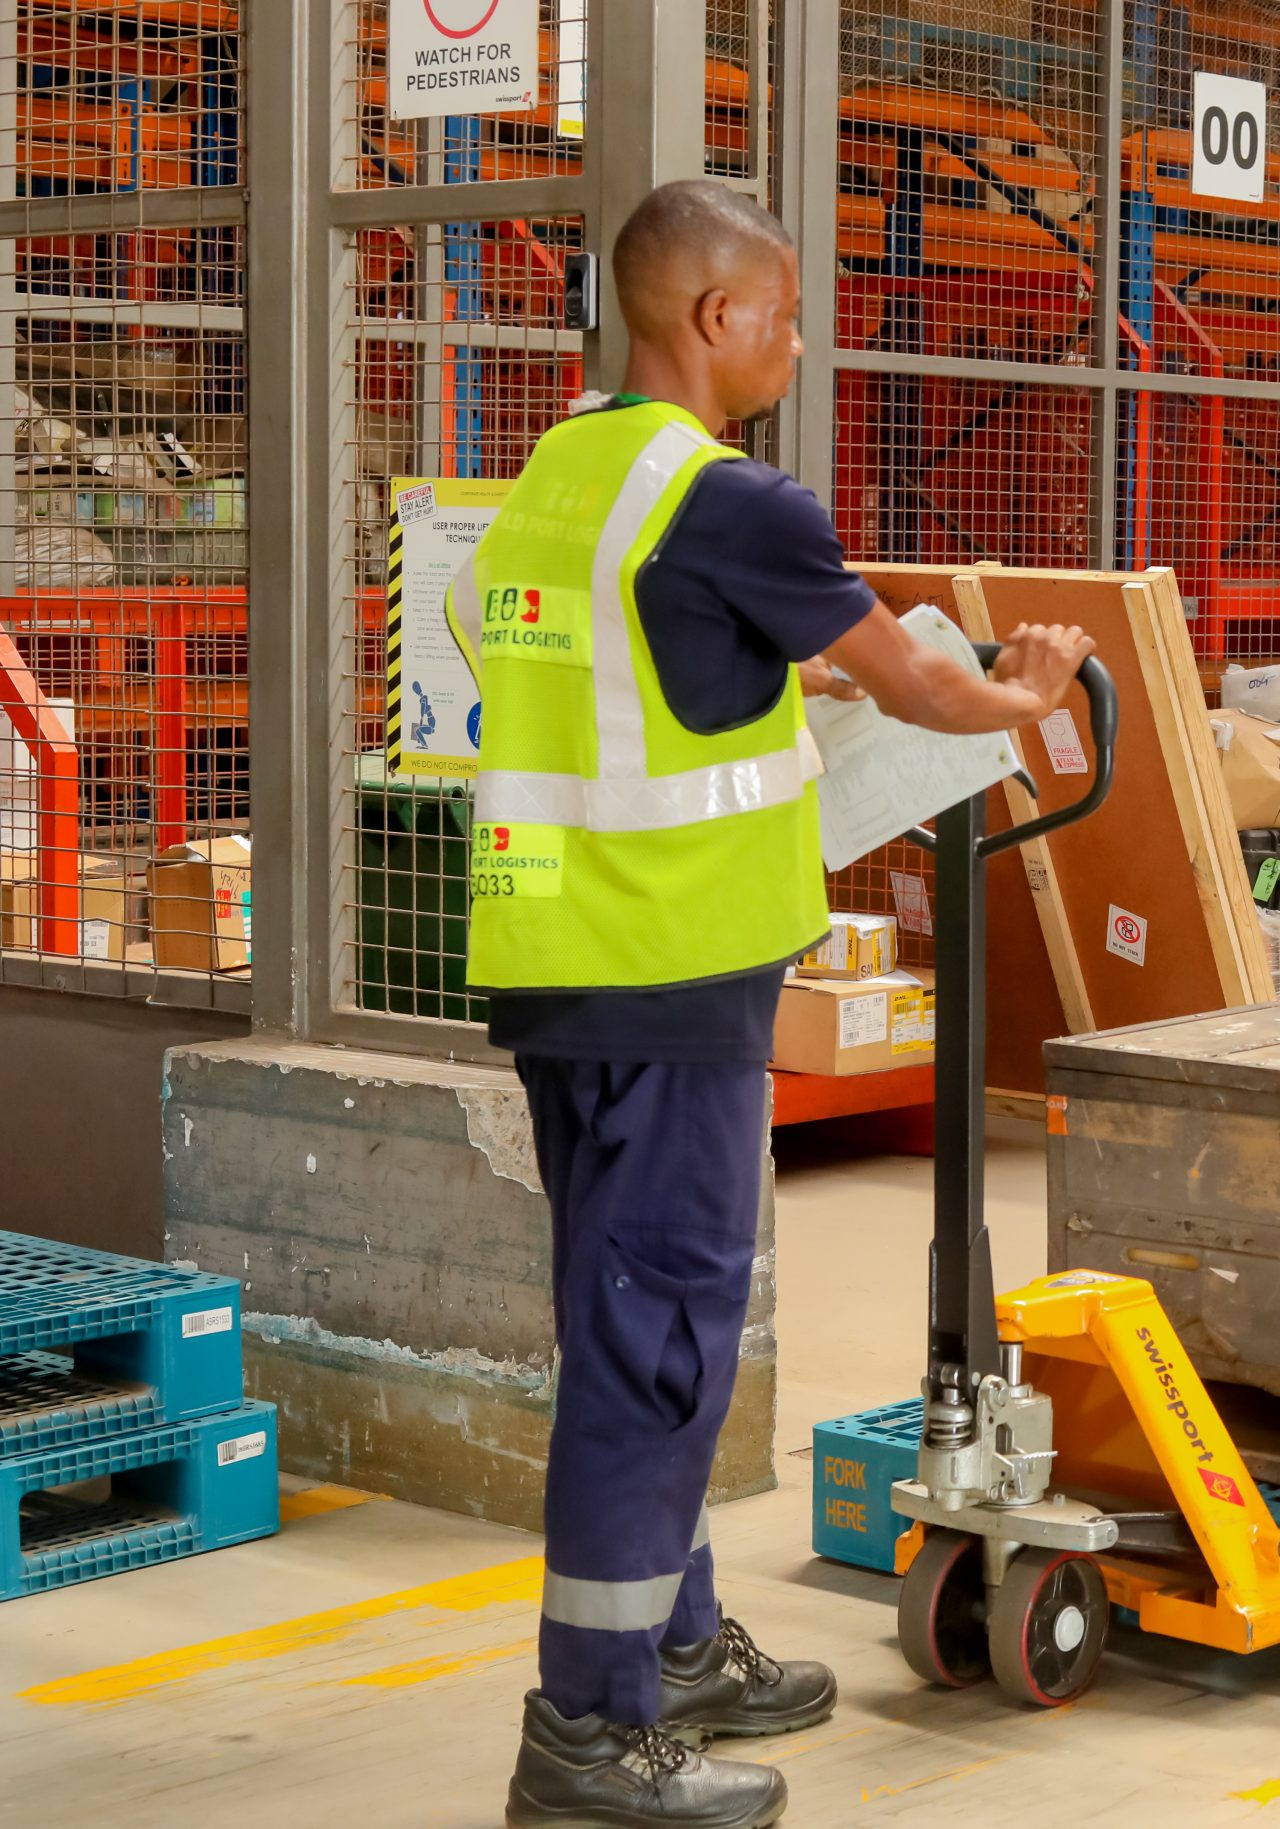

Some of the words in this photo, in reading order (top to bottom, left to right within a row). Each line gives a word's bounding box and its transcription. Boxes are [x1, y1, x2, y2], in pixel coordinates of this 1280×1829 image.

[415, 46, 471, 67] WATCH
[477, 43, 511, 62] FOR
[407, 66, 520, 91] PEDESTRIANS
[495, 94, 522, 103] swissport
[1202, 106, 1258, 170] 00
[399, 494, 407, 503] BE
[400, 499, 414, 514] STAY
[414, 494, 433, 510] ALERT
[414, 509, 423, 519] GET
[423, 506, 434, 517] HURT
[432, 521, 448, 530] USER
[450, 522, 475, 530] PROPER
[482, 629, 508, 646] PORT
[1053, 746, 1079, 754] FRAGILE
[411, 759, 421, 767] WE
[421, 760, 432, 768] DO
[433, 761, 447, 770] NOT
[447, 762, 478, 772] COMPRO
[489, 857, 558, 869] LOGISTICS
[1136, 1326, 1215, 1463] swissport
[825, 1456, 867, 1491] FORK
[825, 1496, 868, 1533] HERE
